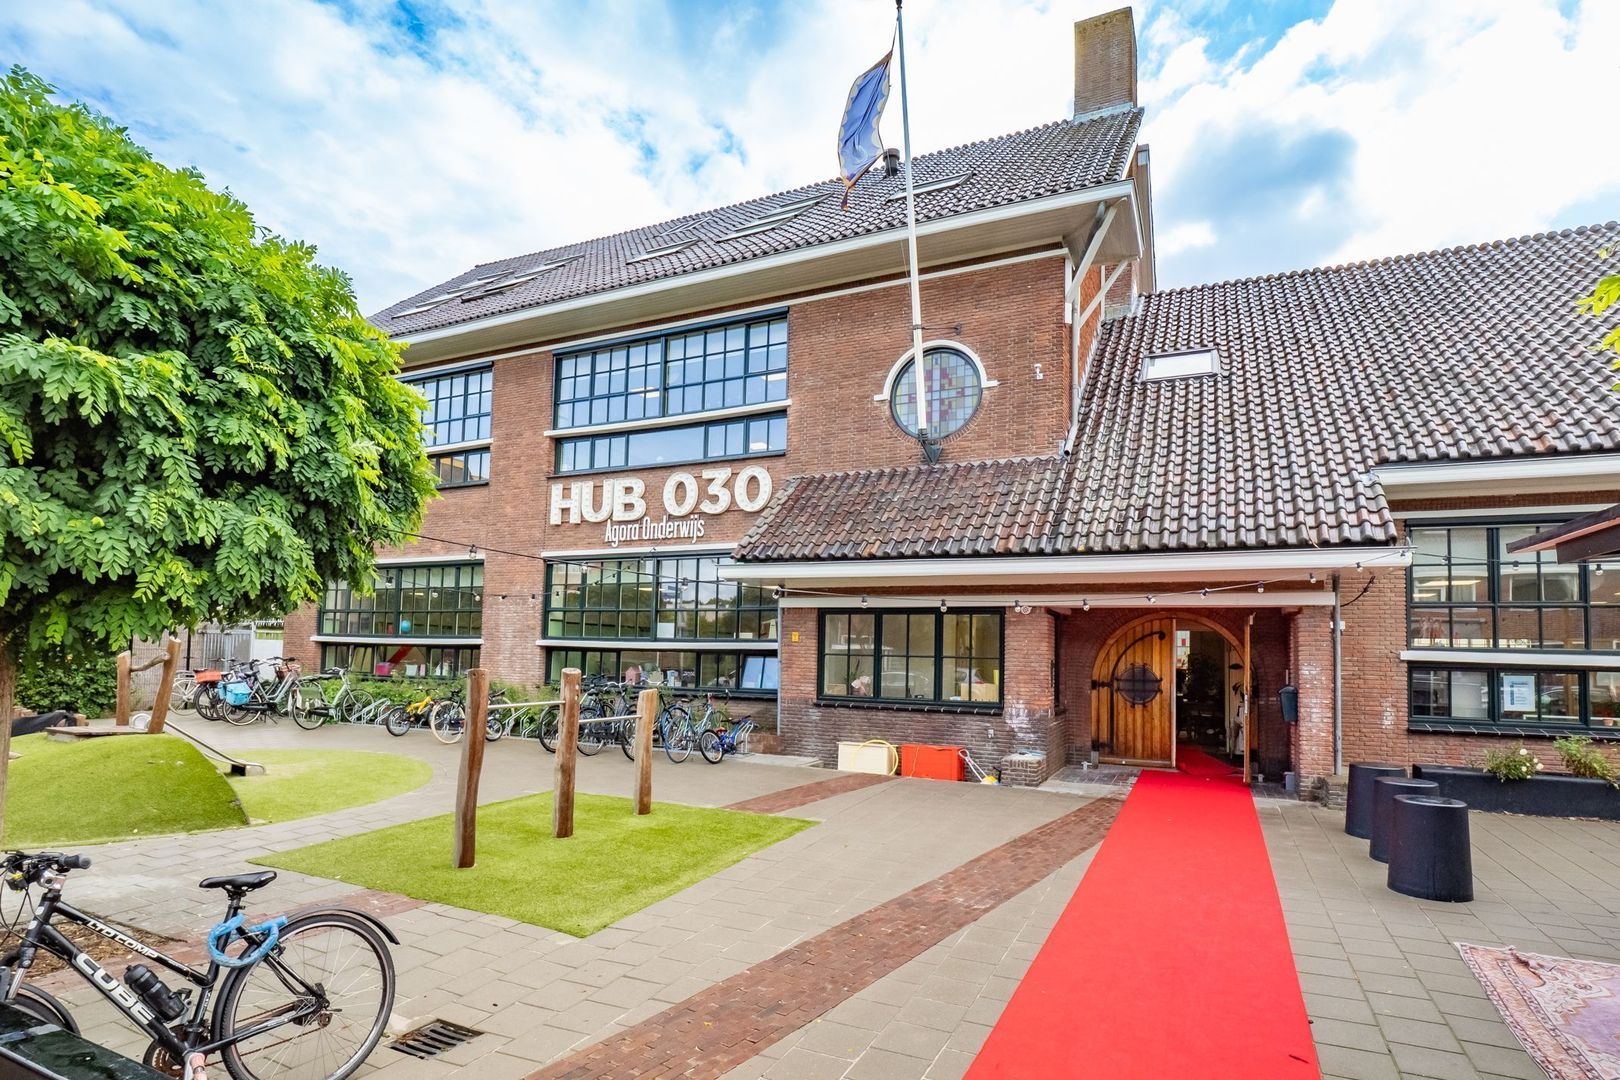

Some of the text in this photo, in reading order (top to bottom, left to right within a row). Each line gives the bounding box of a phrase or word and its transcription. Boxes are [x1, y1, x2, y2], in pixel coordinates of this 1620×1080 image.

[551, 465, 773, 525] HUB 030
[605, 515, 705, 547] Agora Onderwijs
[86, 920, 161, 958] LTD COMP
[76, 952, 156, 1025] CUBE
